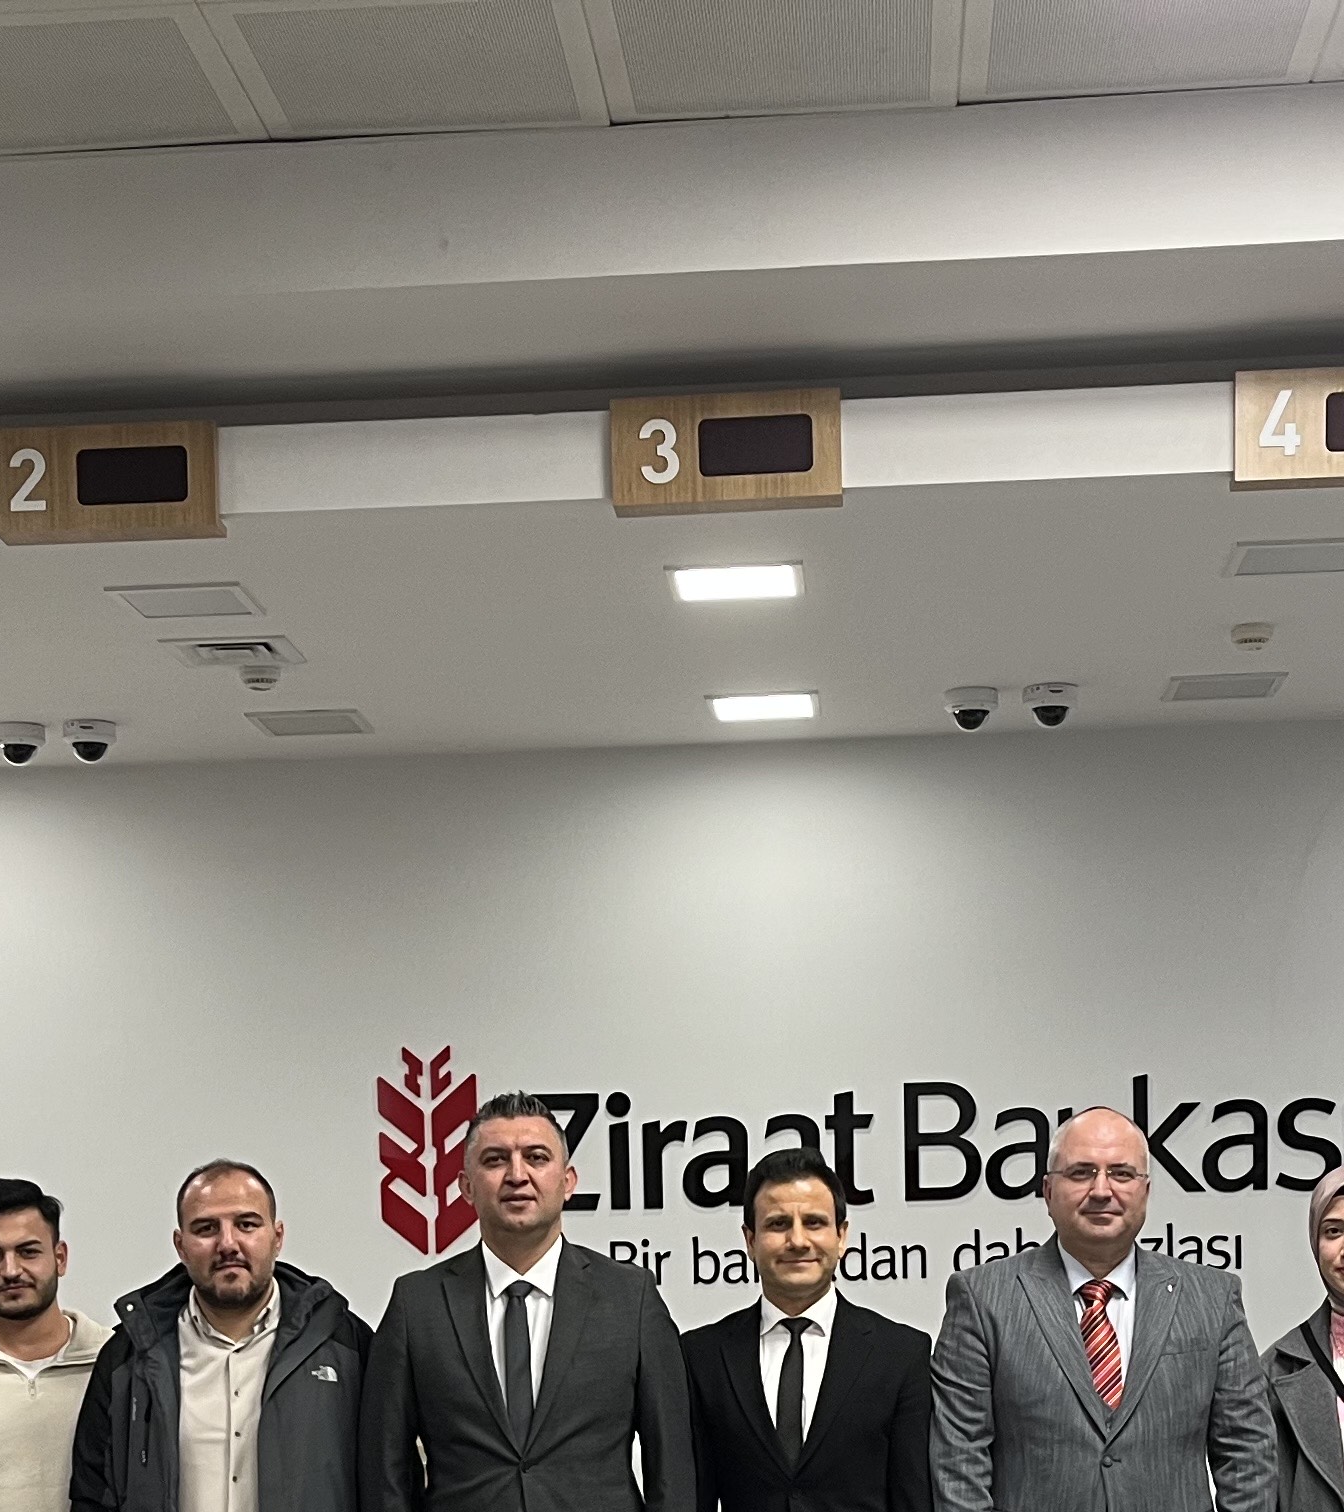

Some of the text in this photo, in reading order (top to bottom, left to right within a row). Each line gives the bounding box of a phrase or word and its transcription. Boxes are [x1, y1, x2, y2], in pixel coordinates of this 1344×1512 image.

[639, 418, 680, 484] 3
[1259, 389, 1301, 456] 4
[9, 448, 46, 512] 2
